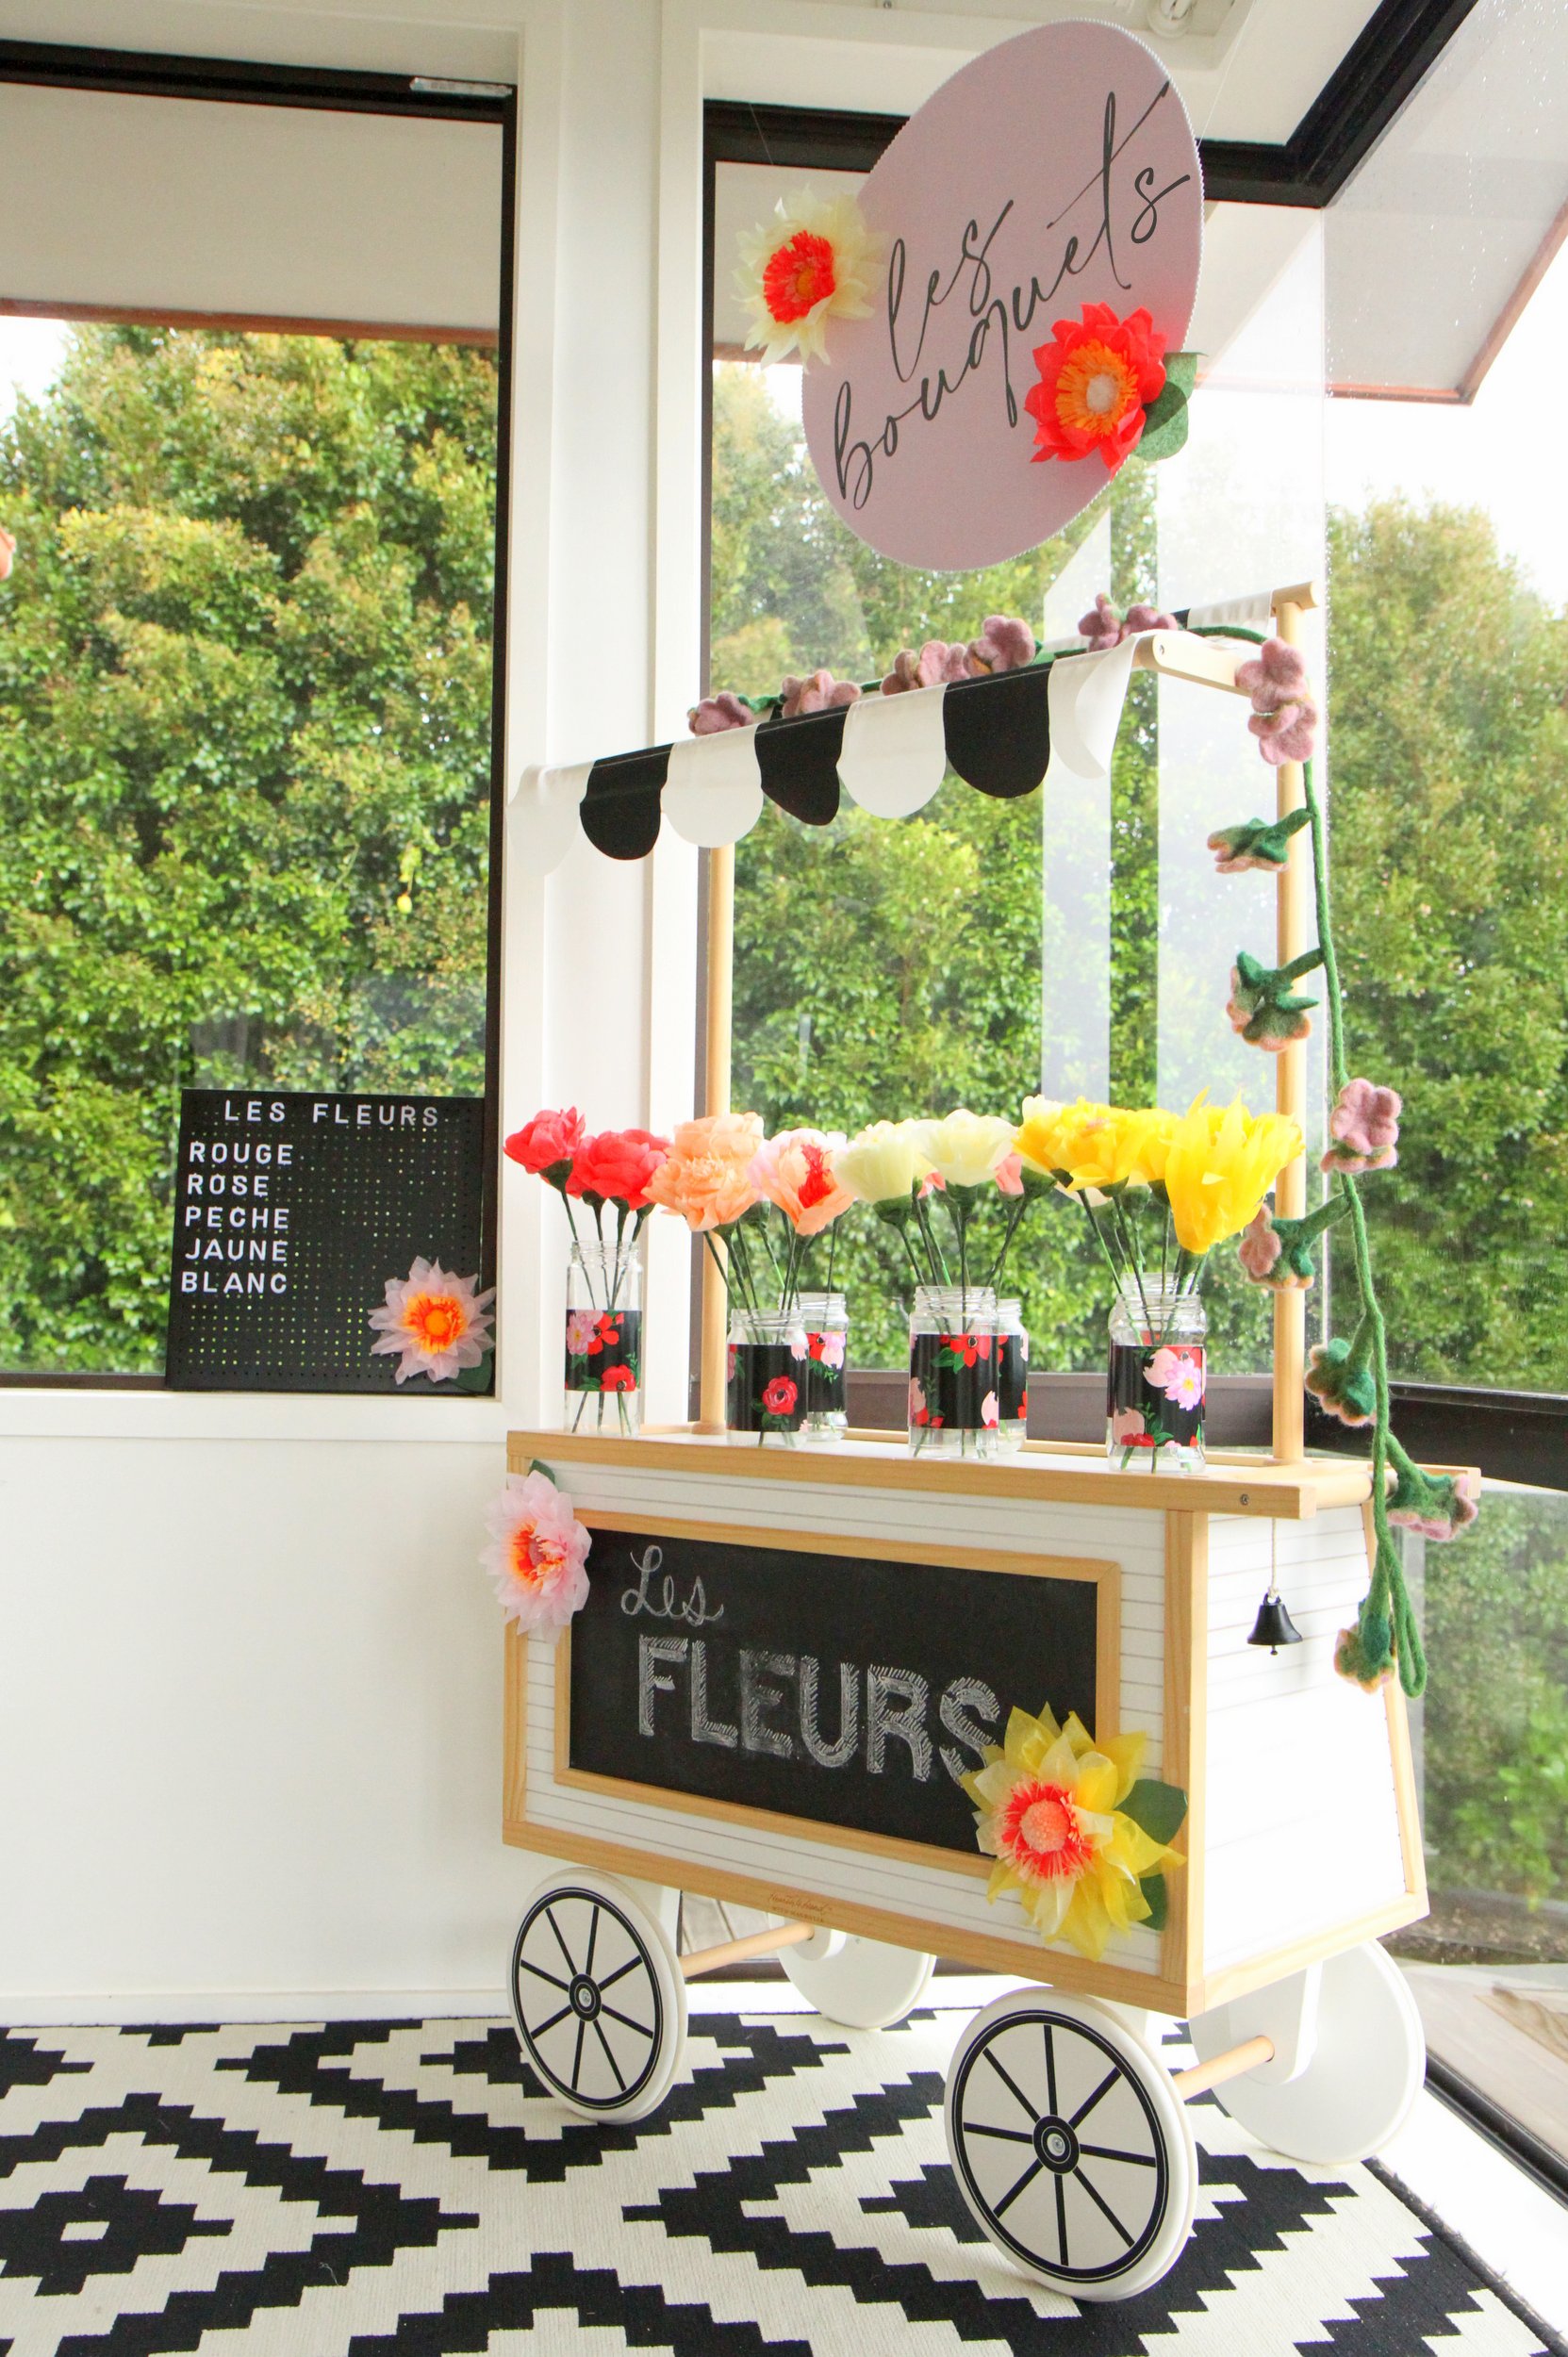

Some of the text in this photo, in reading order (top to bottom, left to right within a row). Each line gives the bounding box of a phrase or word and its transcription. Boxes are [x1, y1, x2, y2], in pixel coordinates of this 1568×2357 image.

[834, 81, 1191, 510] bouquets
[888, 199, 1014, 383] les
[224, 1099, 438, 1127] LES FLEURS
[189, 1142, 293, 1165] ROUGE
[188, 1174, 269, 1196] ROSE
[185, 1206, 290, 1229] PECHE
[185, 1238, 289, 1261] JAUNE
[180, 1271, 288, 1294] BLANC
[620, 1545, 724, 1626] Les
[638, 1634, 1000, 1788] FLEURS
